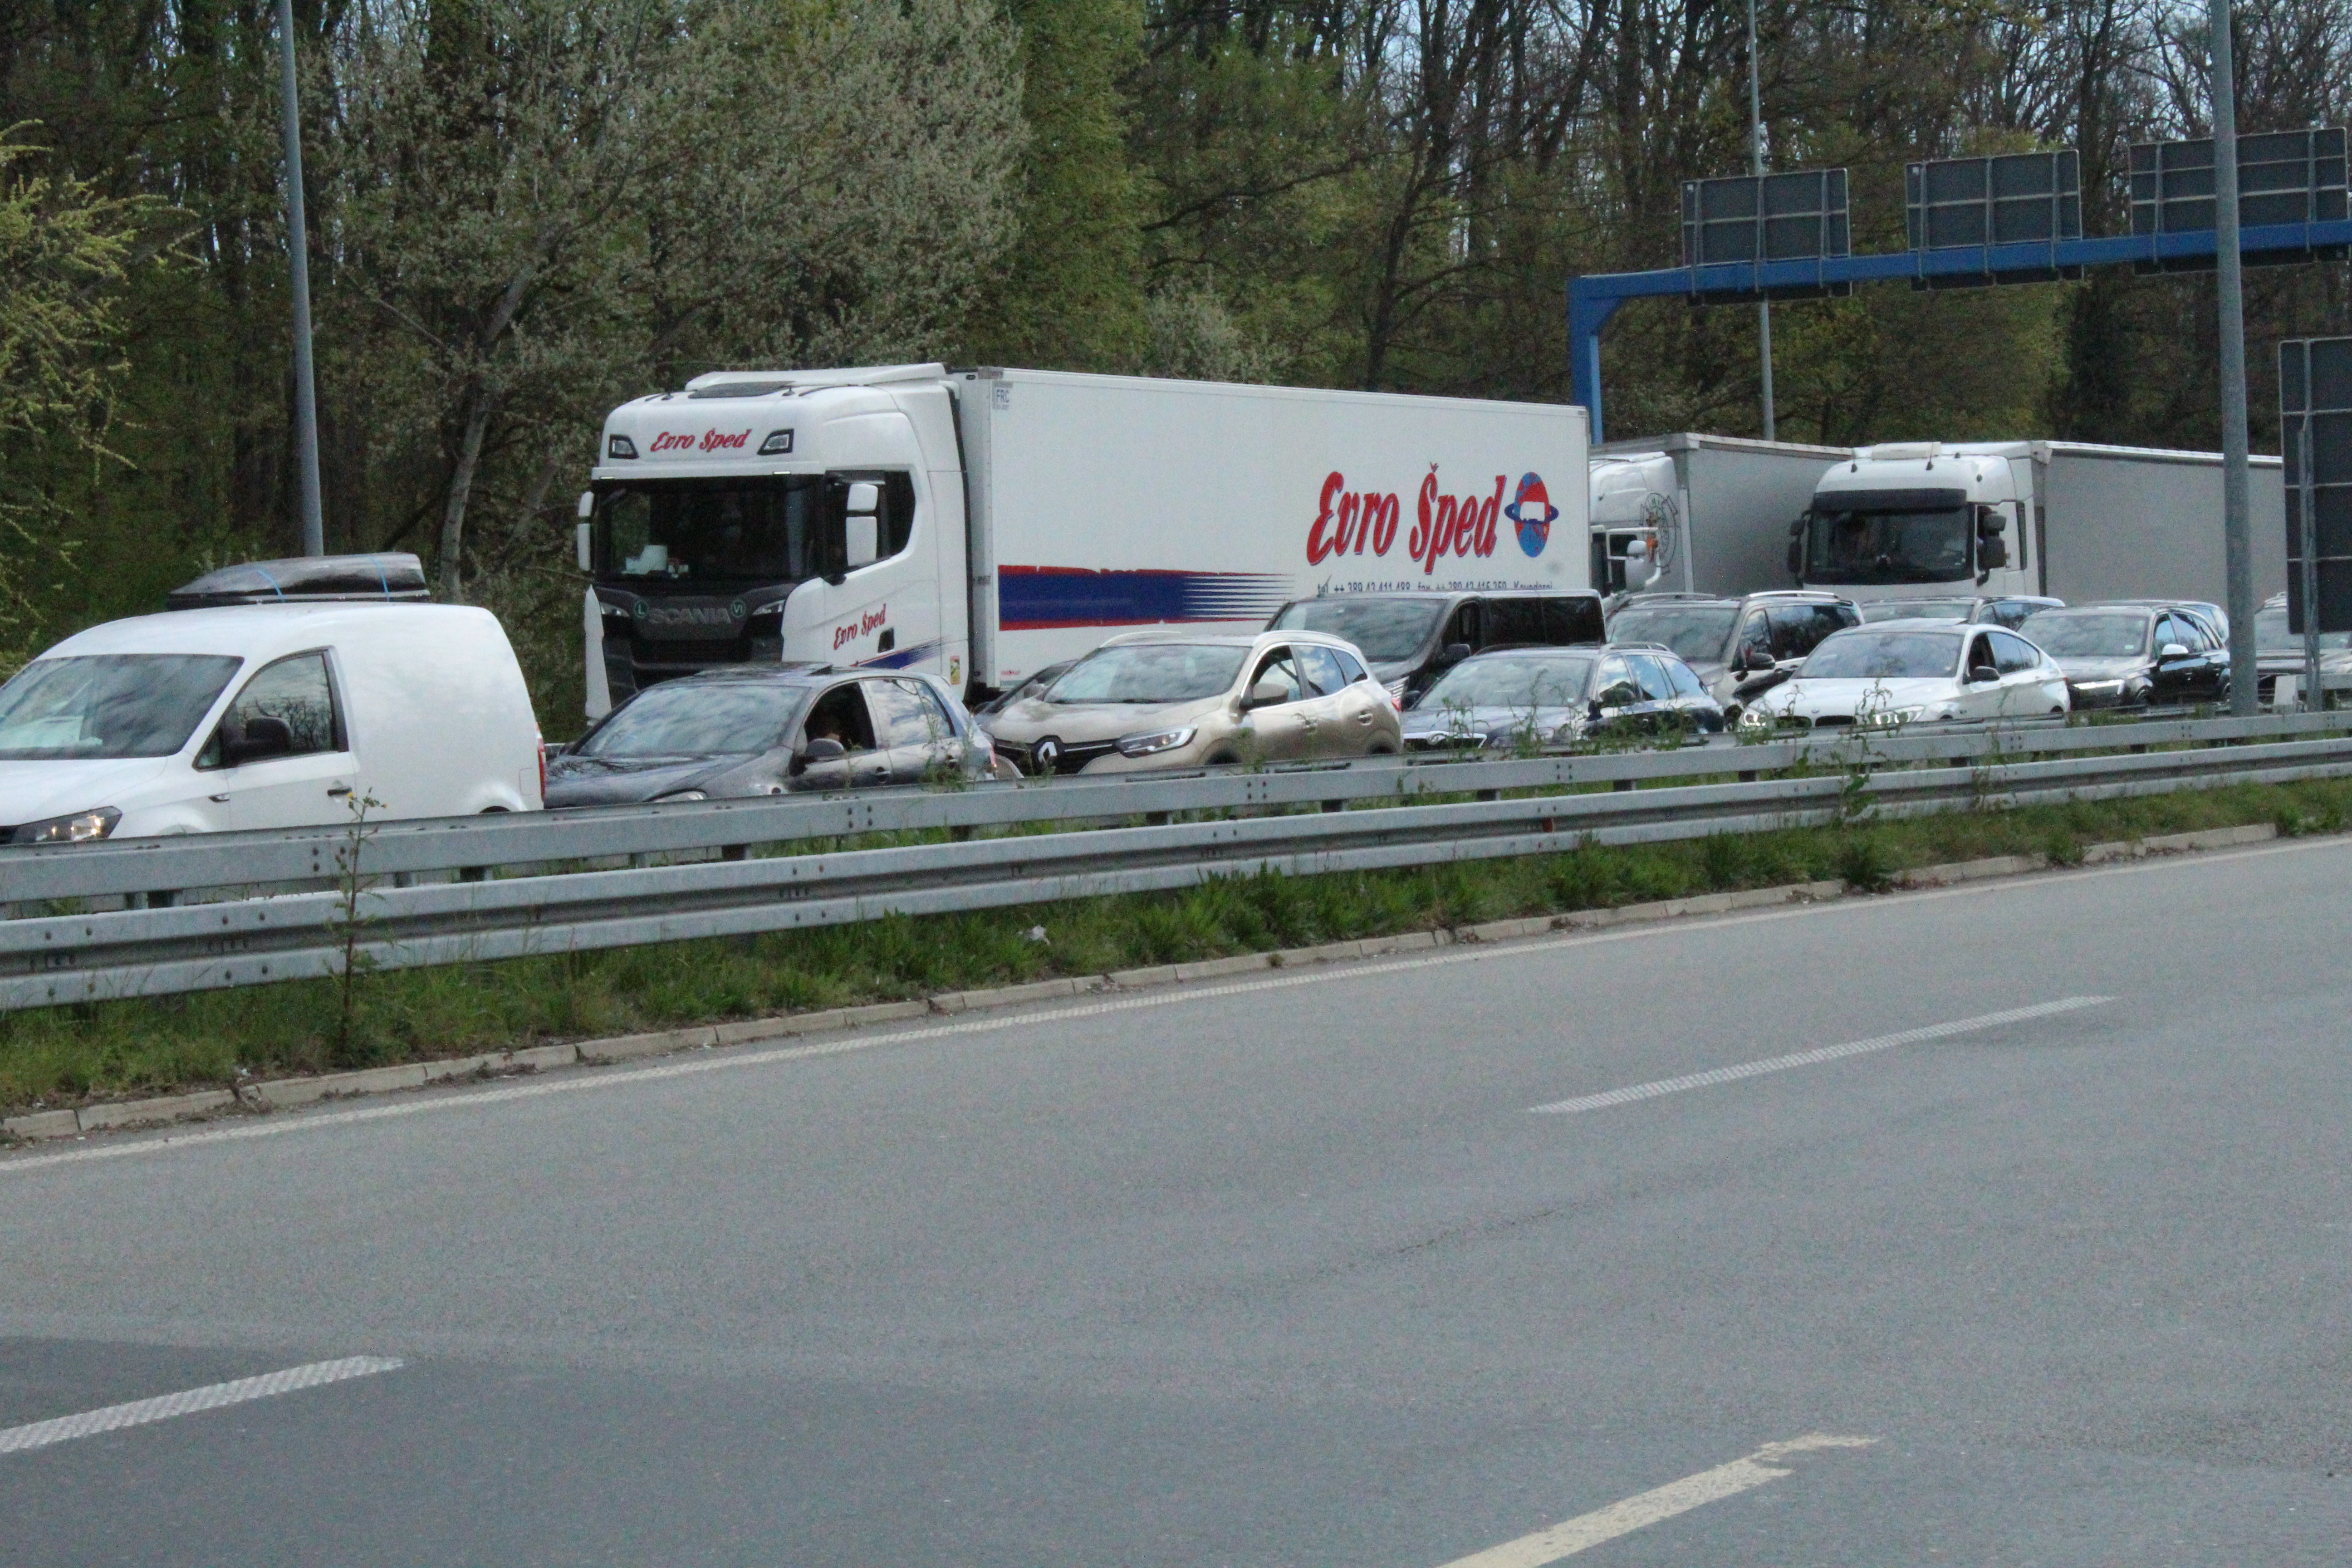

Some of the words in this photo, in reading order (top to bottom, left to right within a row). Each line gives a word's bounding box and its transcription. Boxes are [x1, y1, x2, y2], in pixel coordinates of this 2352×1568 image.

[996, 389, 1009, 403] FRC
[638, 604, 645, 614] L
[648, 607, 731, 625] SCANIA
